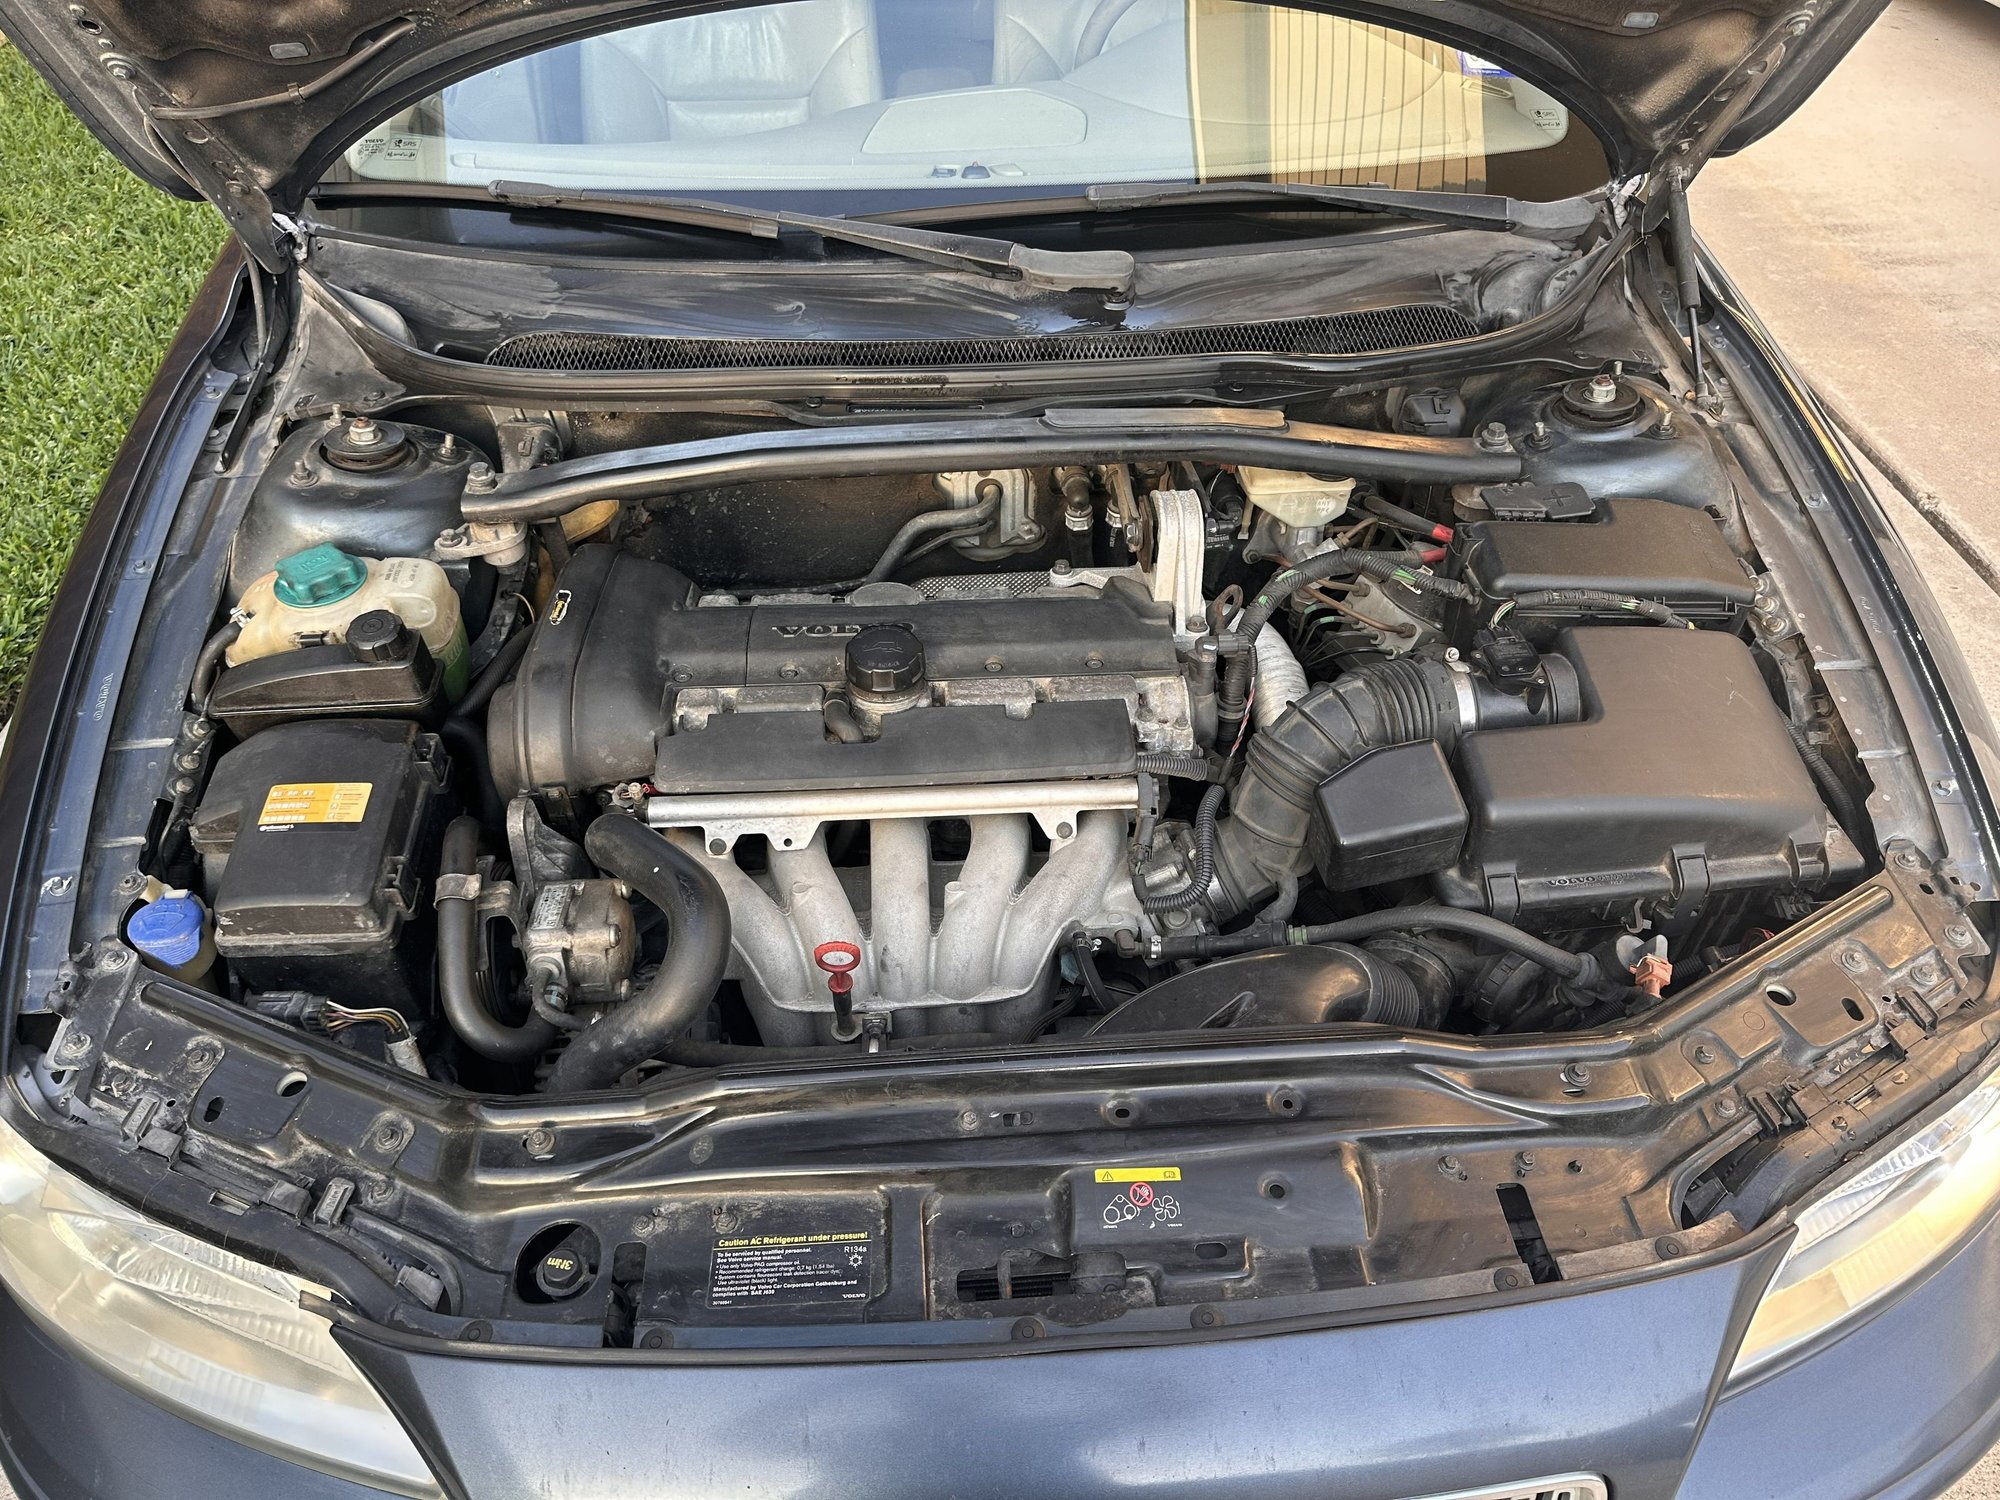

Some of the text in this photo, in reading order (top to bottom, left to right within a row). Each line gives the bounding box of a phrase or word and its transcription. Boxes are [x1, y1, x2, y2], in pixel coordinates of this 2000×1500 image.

[772, 622, 915, 638] VOL
[93, 672, 114, 721] VOLVO
[1546, 875, 1595, 886] VOLVO
[719, 1231, 868, 1247] Caution AC Refrigerant under pressure!
[546, 1257, 574, 1271] 3Nm
